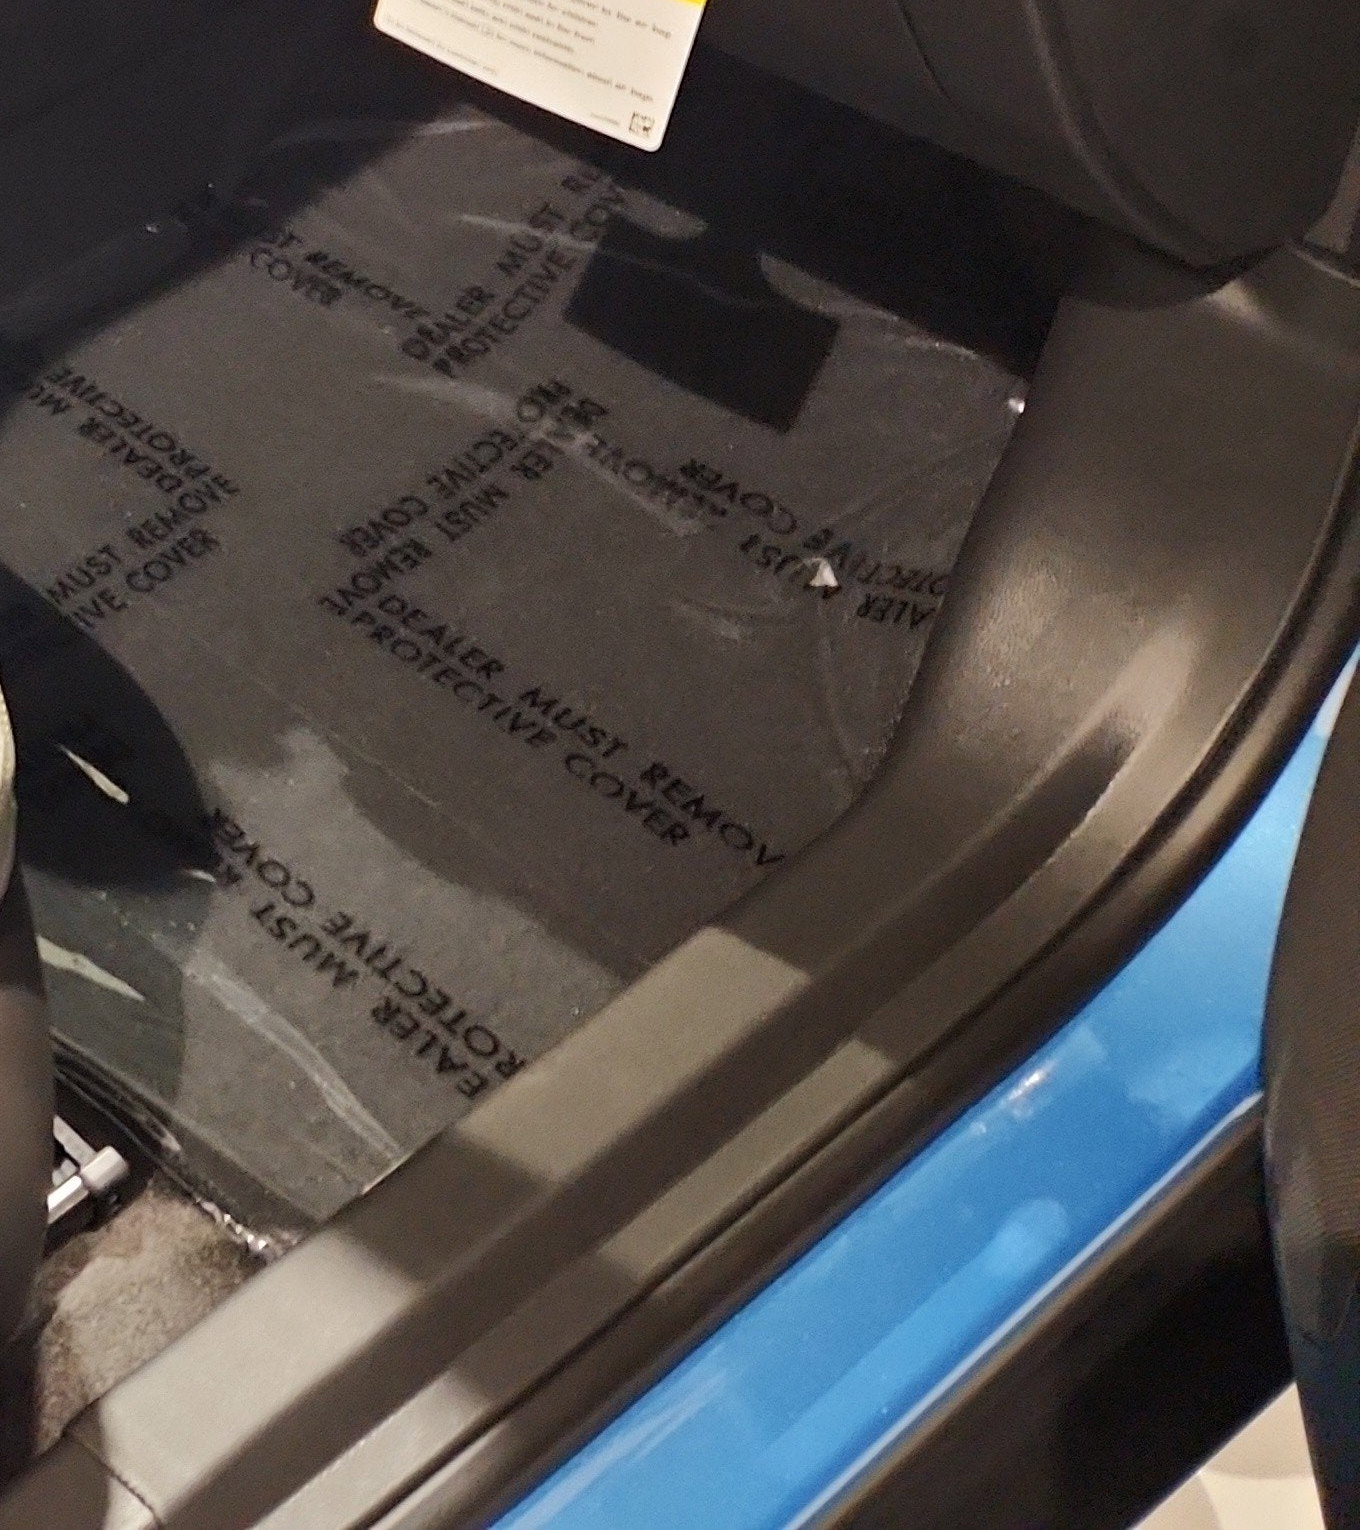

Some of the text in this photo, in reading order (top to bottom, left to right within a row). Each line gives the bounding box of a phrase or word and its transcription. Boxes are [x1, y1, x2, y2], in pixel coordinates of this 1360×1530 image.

[402, 284, 496, 361] DEALER
[432, 244, 578, 378] PROTECTIVE
[79, 416, 184, 494] DEALER
[340, 494, 429, 558] COVER
[433, 481, 511, 543] MUST
[679, 457, 798, 536] COVER
[45, 472, 240, 605] MUST REMOVE
[126, 527, 220, 593] COVER
[318, 537, 432, 617] REMOVE
[351, 611, 692, 846] PROTECTIVE COVER
[379, 593, 785, 868] DEALER MUST REMOV
[250, 902, 360, 989] MUST
